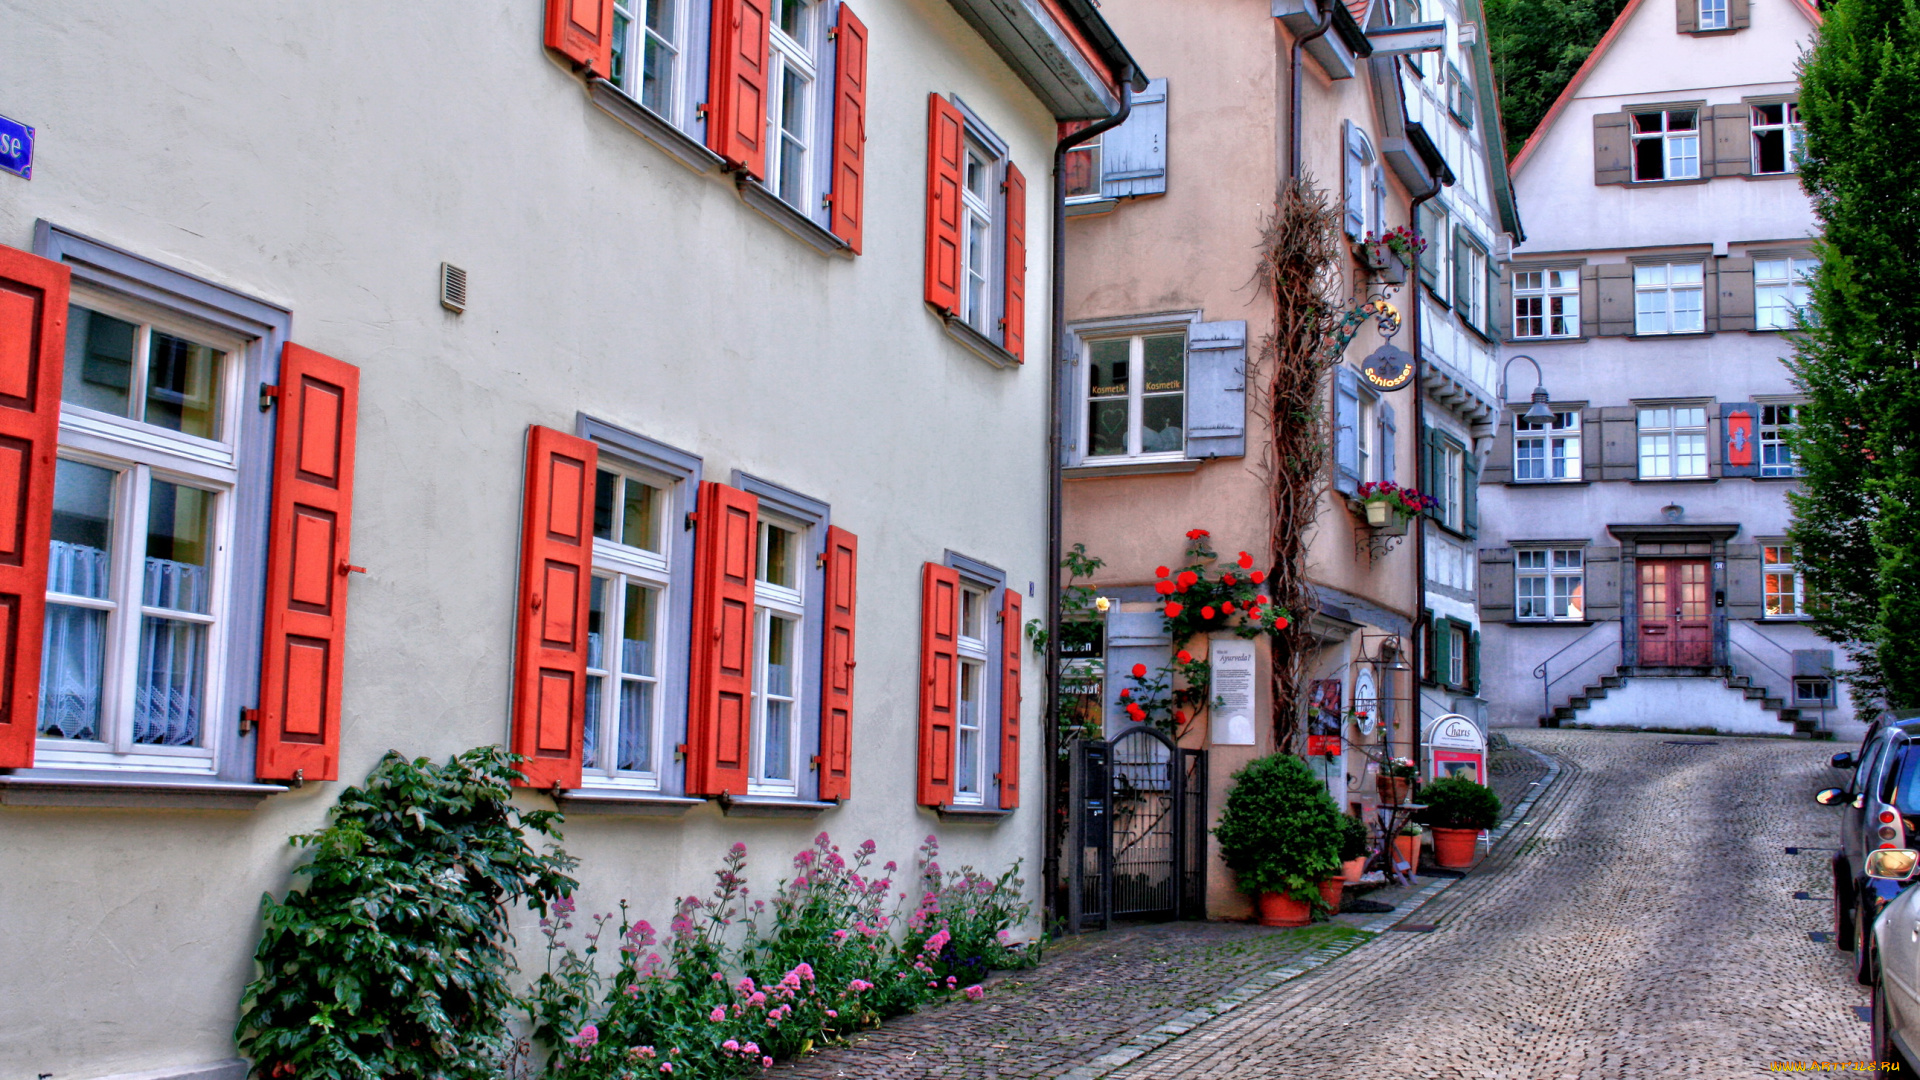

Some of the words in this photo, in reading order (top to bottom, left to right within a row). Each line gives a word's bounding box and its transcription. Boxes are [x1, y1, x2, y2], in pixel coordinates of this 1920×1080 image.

[1364, 363, 1413, 387] Schlosser
[1092, 384, 1126, 393] Kosmetik
[1146, 380, 1180, 390] Kosmetik
[1219, 653, 1251, 664] Ayurveda?
[1445, 721, 1471, 737] Charis
